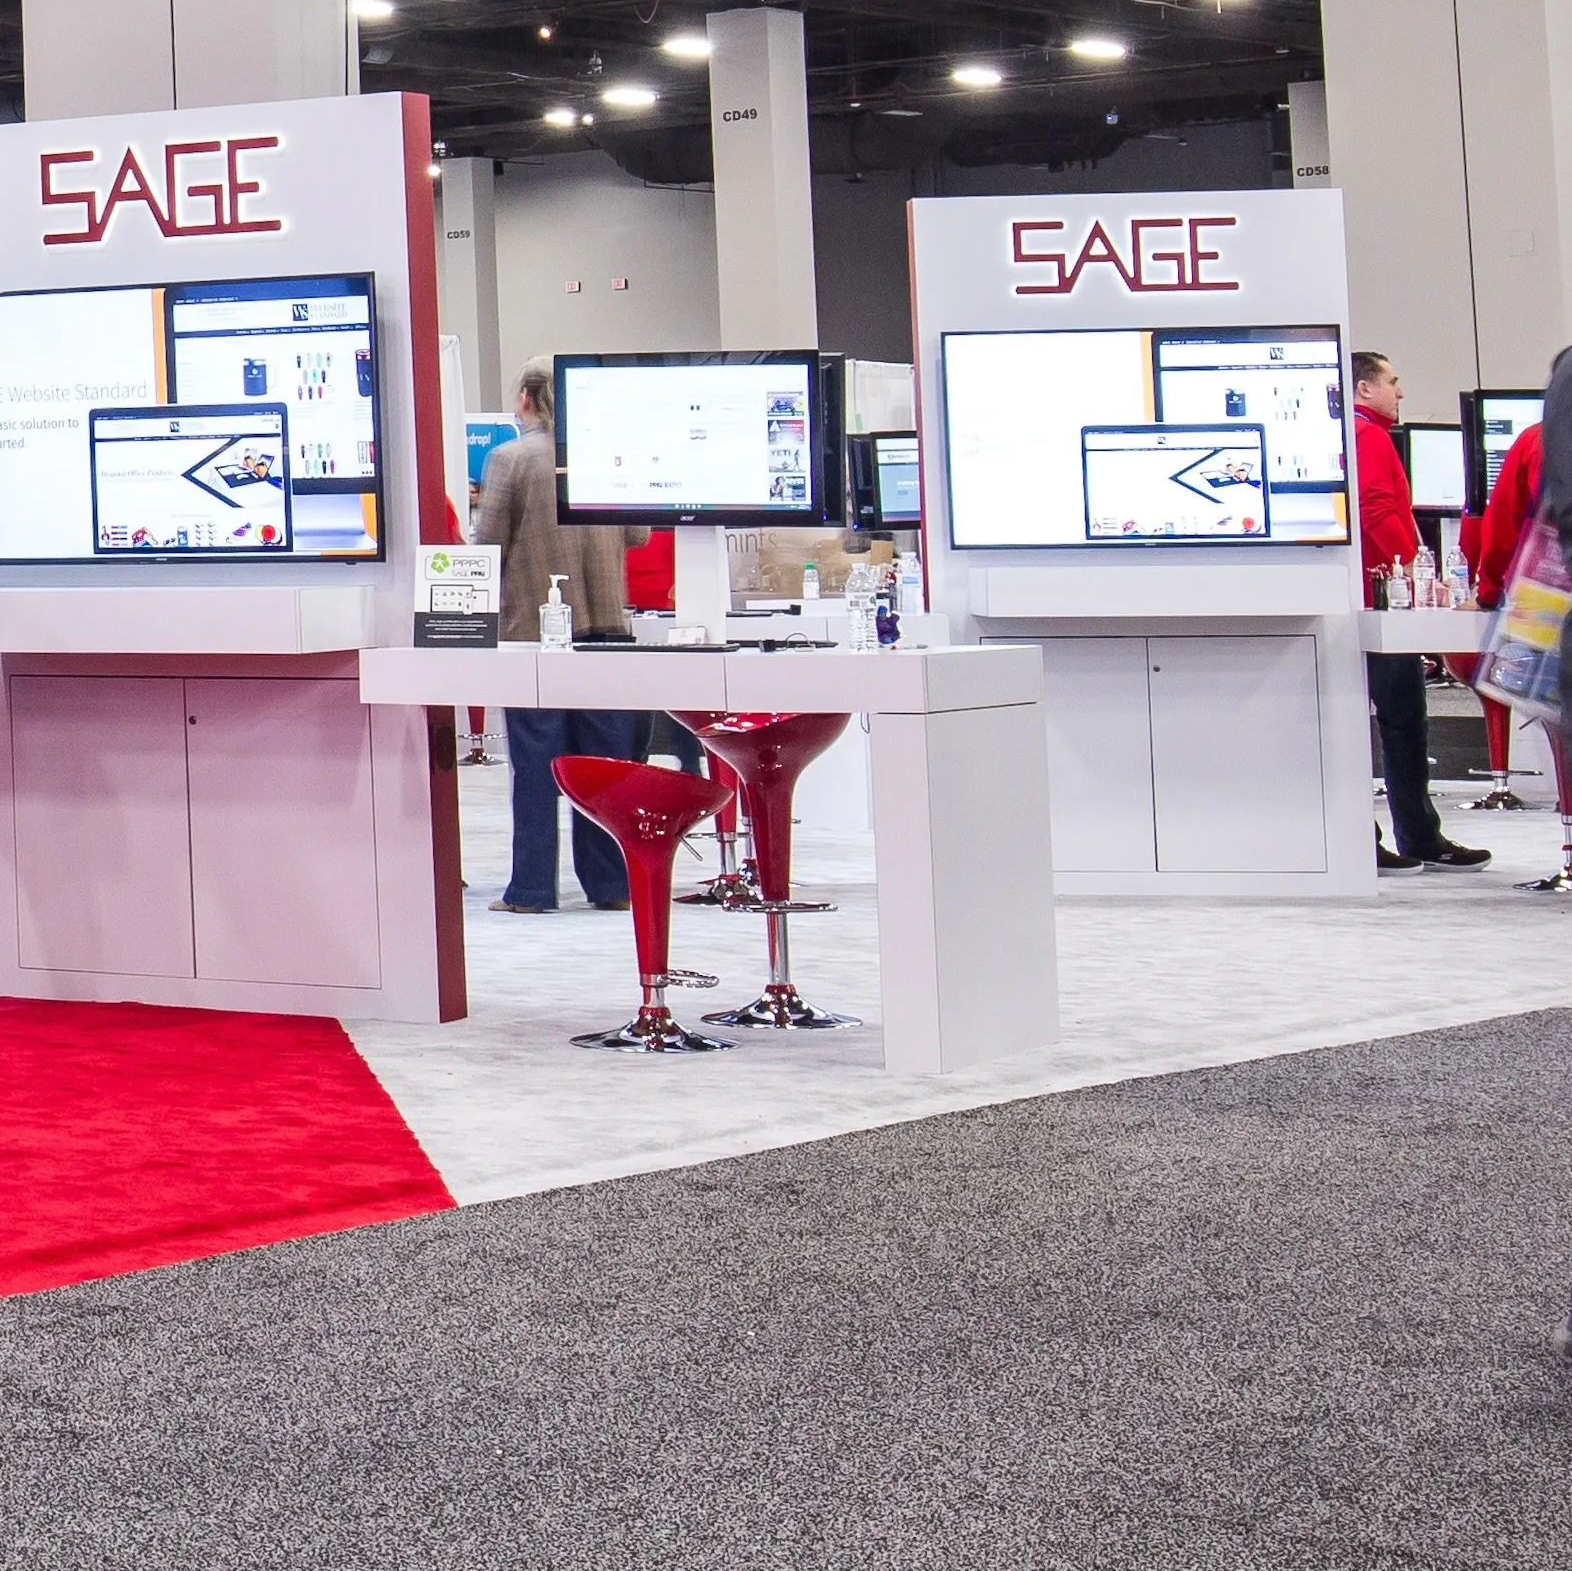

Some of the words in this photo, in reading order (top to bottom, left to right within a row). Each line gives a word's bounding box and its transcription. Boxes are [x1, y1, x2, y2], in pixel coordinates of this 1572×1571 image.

[722, 108, 758, 123] CD49
[1297, 165, 1329, 177] CD58
[39, 136, 283, 246] SAGE
[446, 229, 471, 240] CD59
[1011, 216, 1240, 294] SAGE
[8, 384, 71, 403] Website
[74, 381, 147, 401] Standard
[20, 418, 65, 430] solution
[68, 418, 79, 429] to
[452, 559, 486, 568] PPPC
